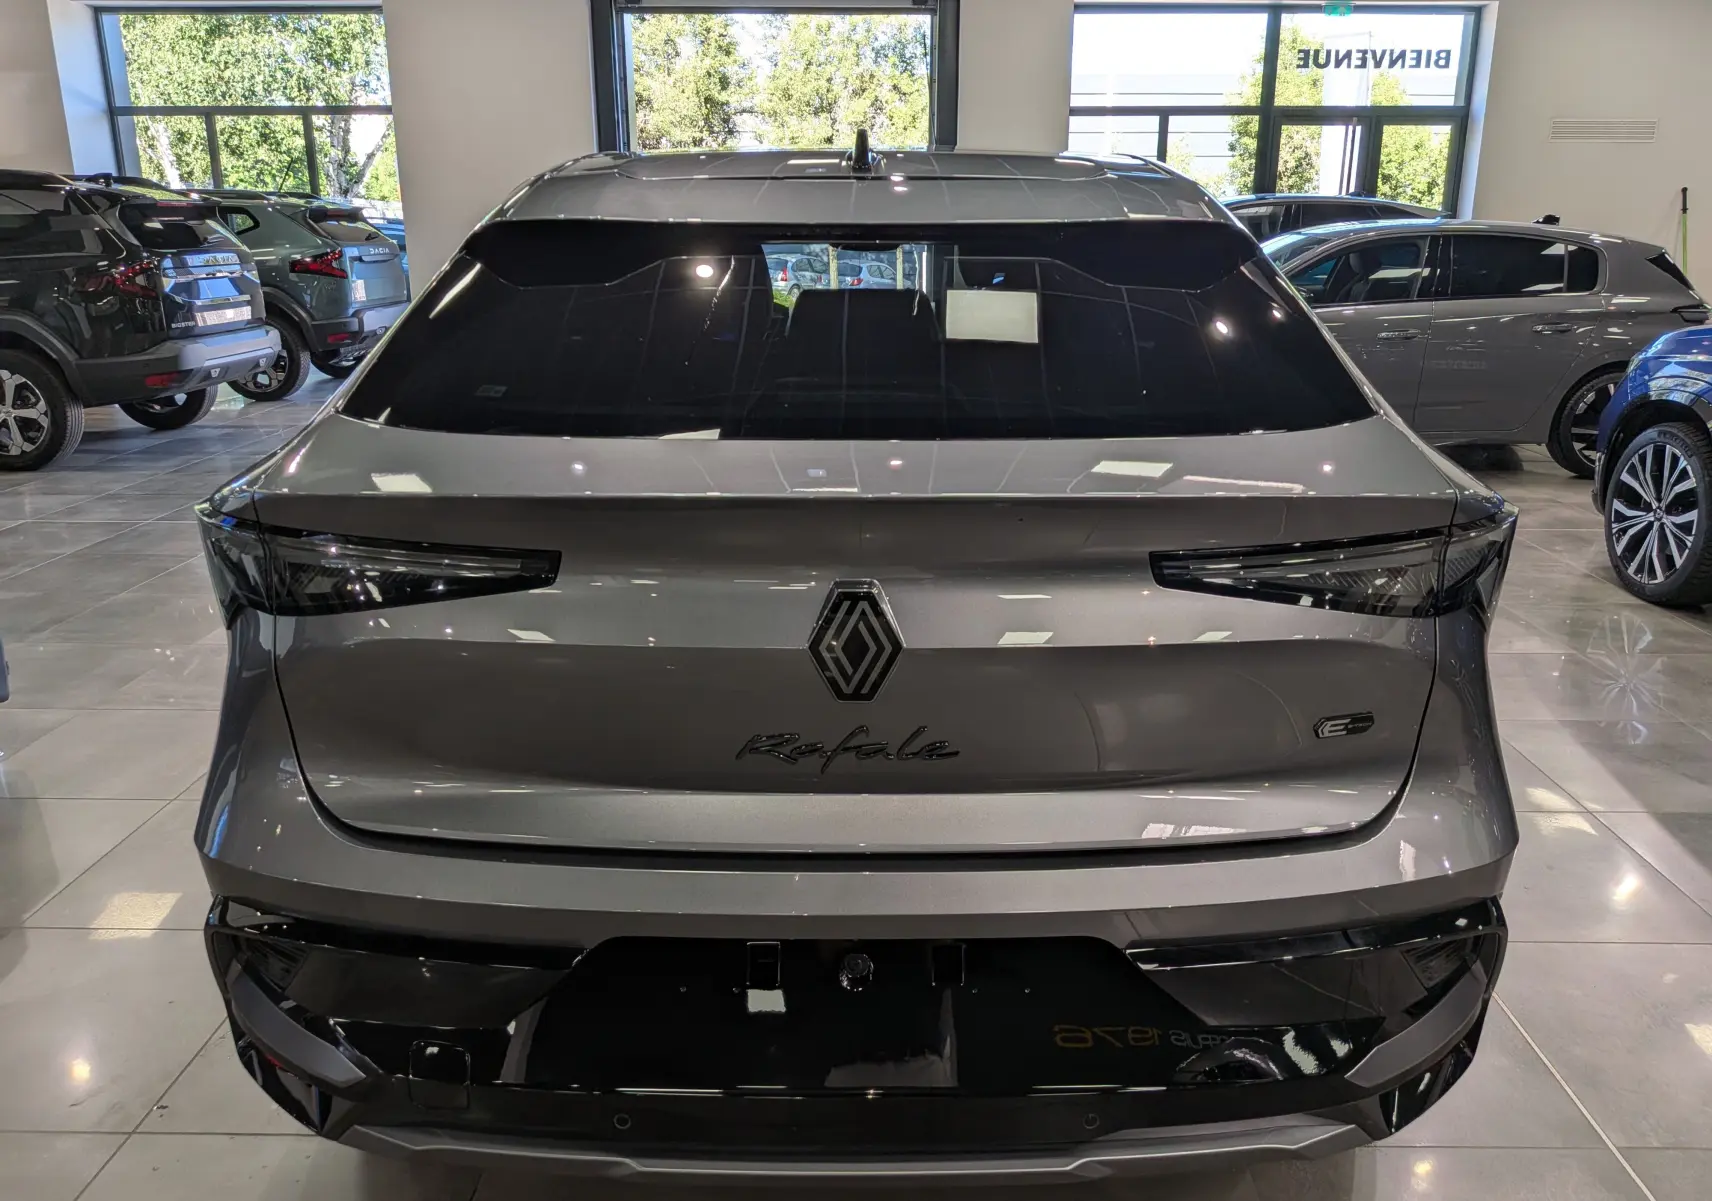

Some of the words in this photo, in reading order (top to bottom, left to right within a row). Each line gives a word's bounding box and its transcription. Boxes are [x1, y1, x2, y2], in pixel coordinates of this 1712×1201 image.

[369, 247, 390, 255] DACIA
[171, 320, 196, 329] BIGSTER
[735, 724, 960, 774] Rafale
